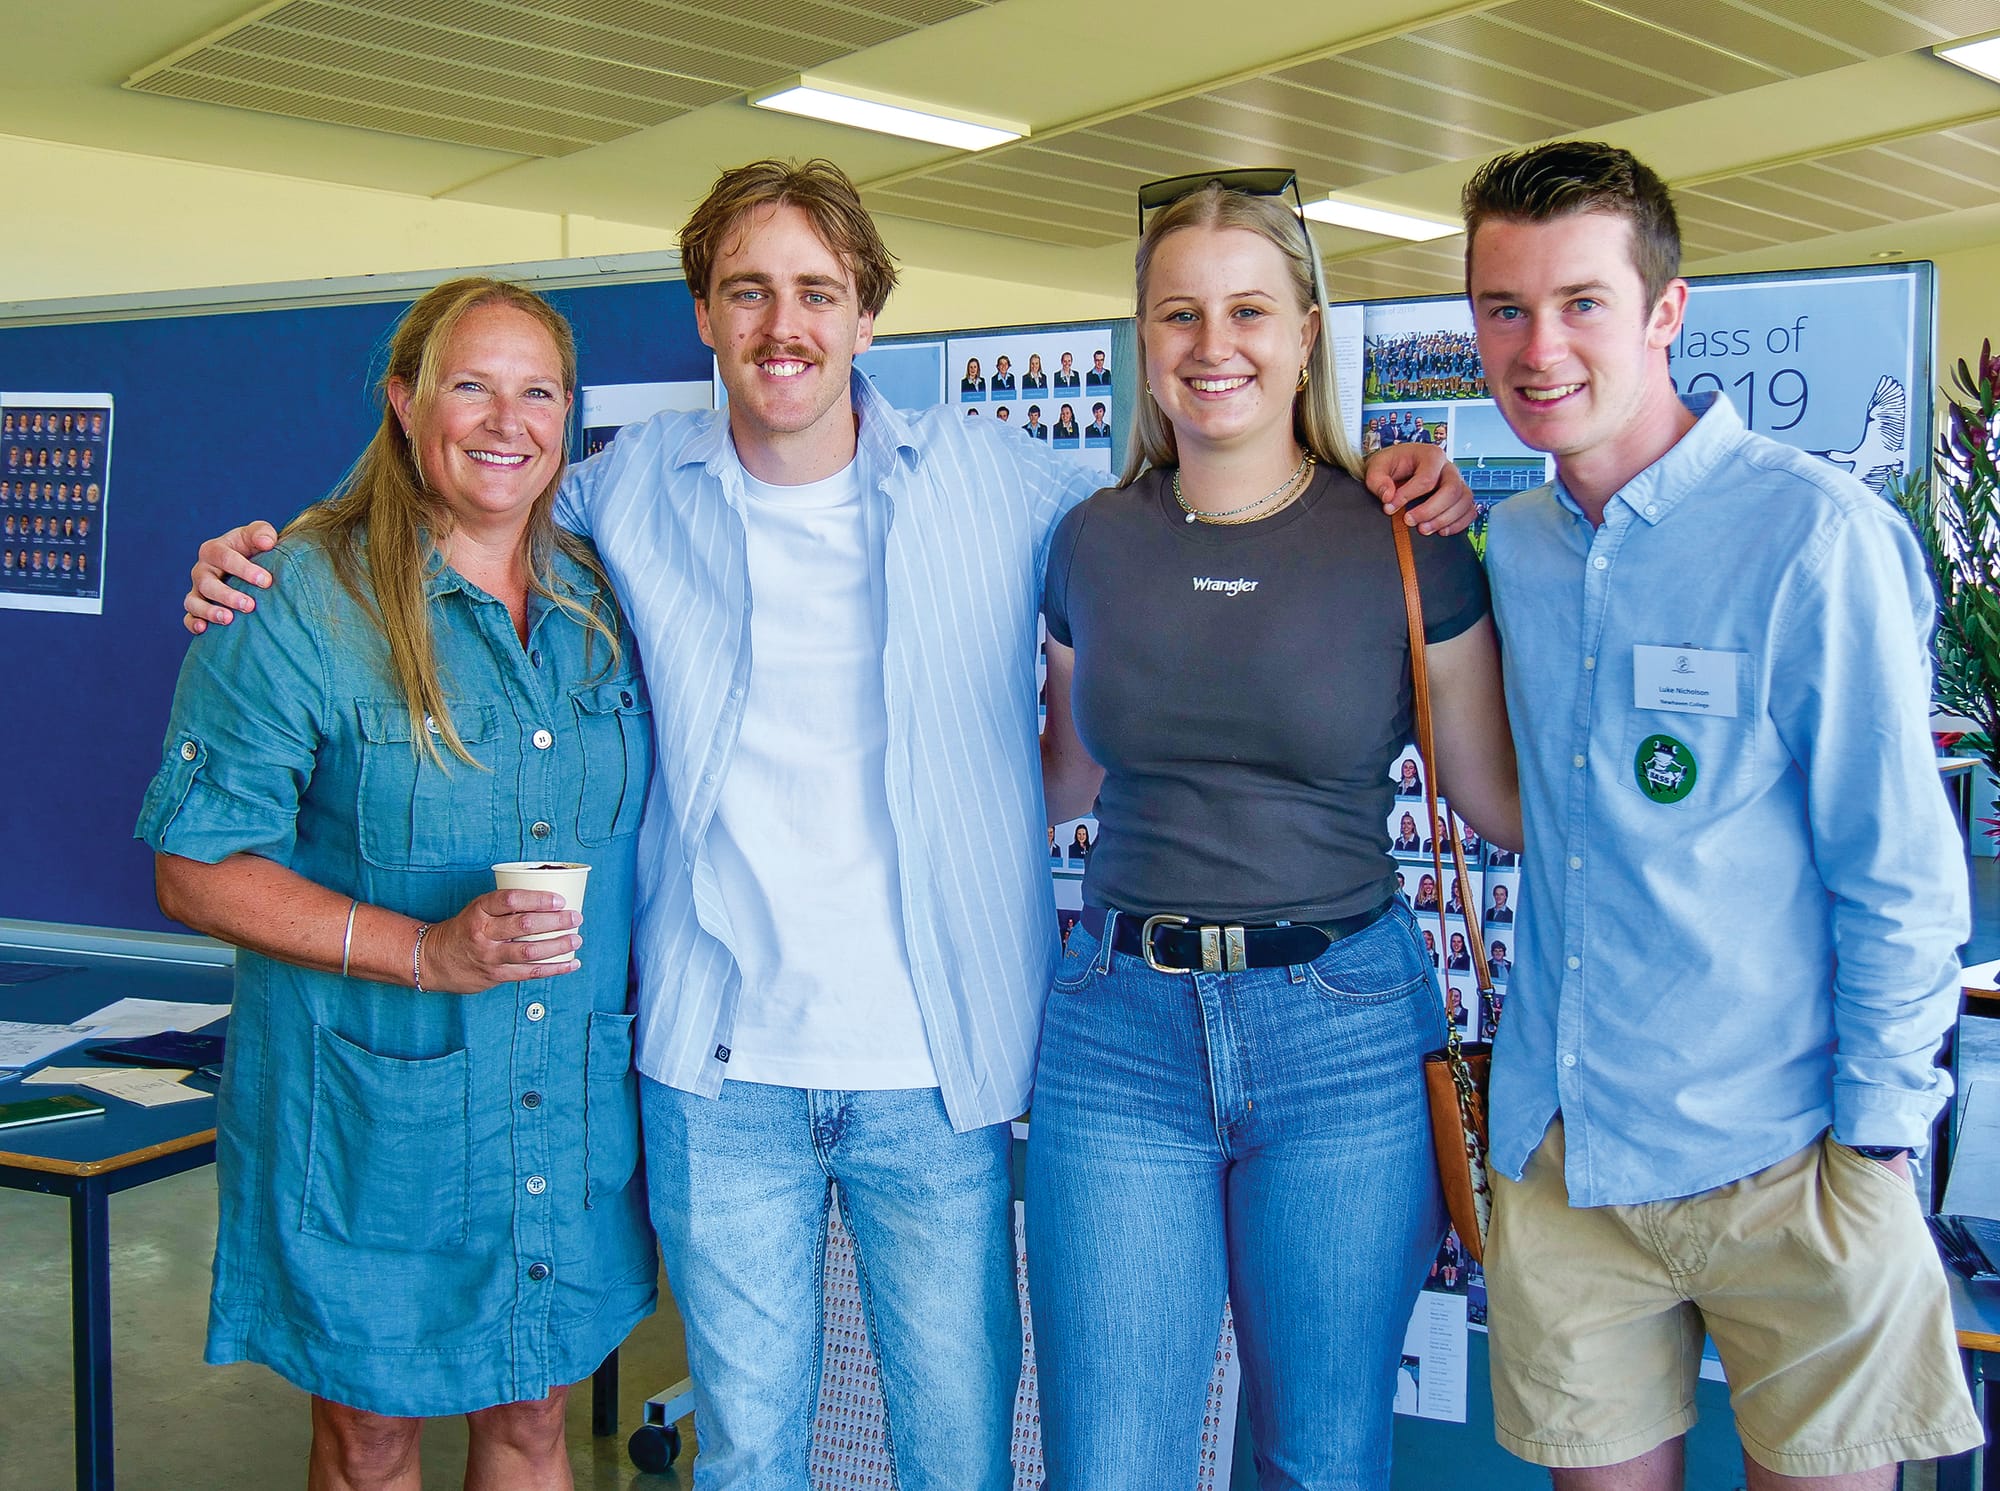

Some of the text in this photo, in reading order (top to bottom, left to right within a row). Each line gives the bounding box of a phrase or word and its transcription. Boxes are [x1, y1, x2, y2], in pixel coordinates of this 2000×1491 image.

[1669, 315, 1809, 359] lass of
[1670, 369, 1809, 431] 19
[1192, 577, 1259, 596] Wrangler
[1659, 686, 1710, 696] Luke Nicholson
